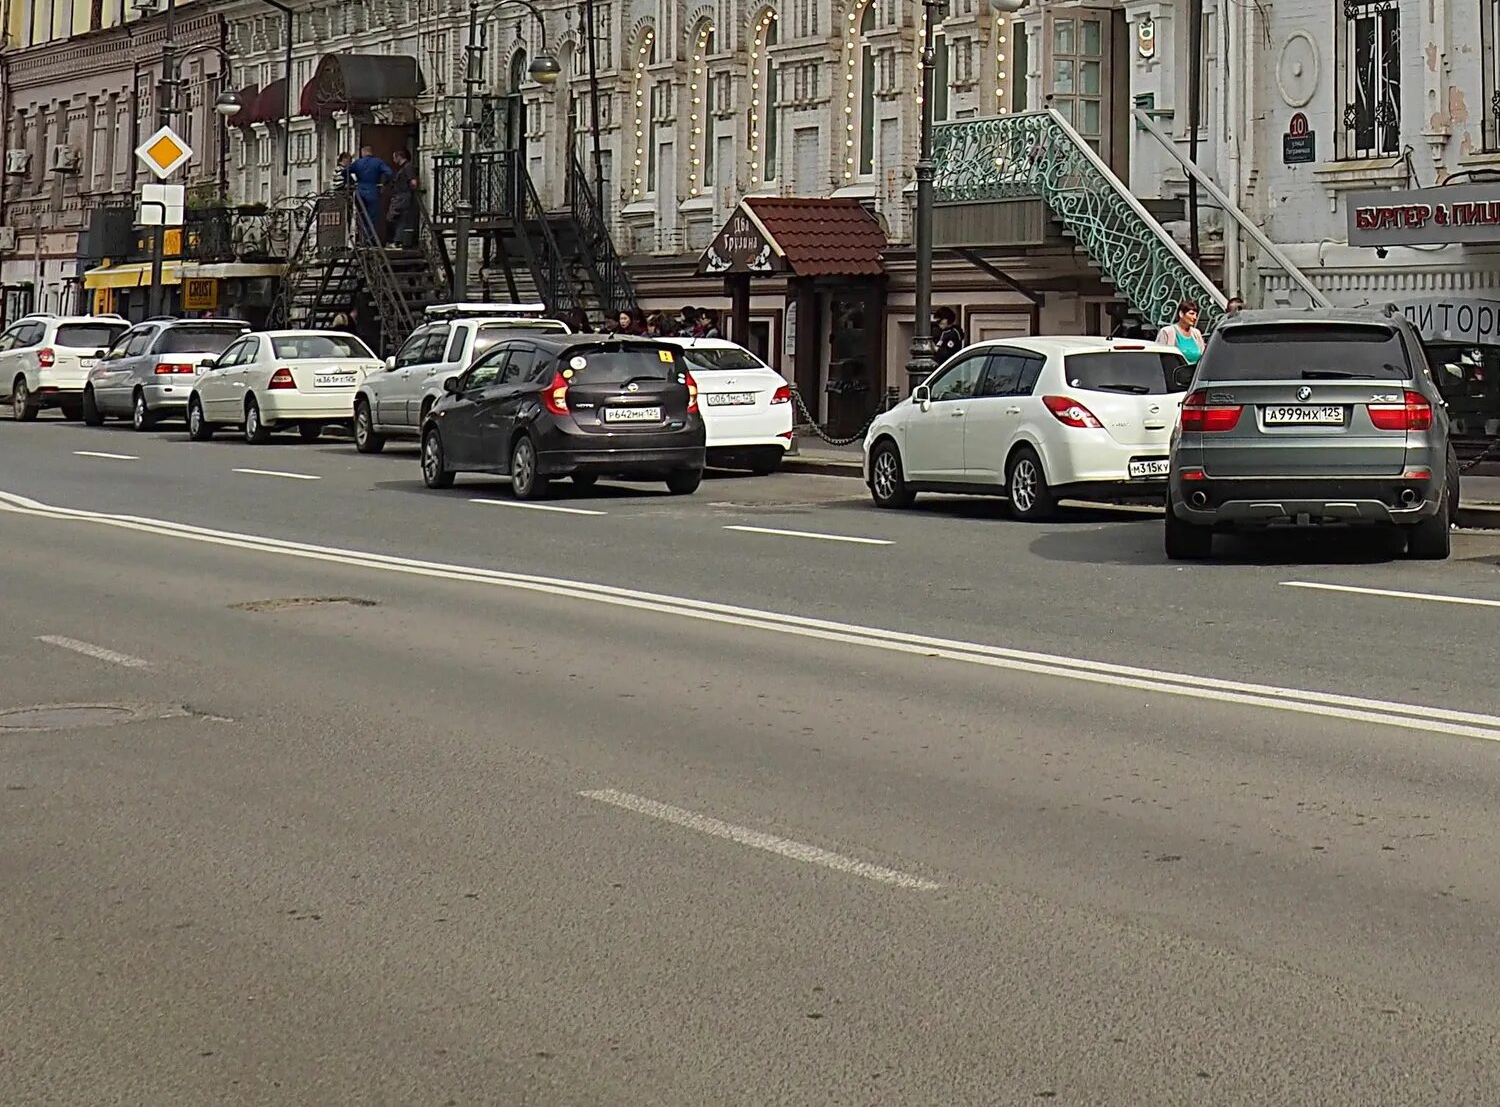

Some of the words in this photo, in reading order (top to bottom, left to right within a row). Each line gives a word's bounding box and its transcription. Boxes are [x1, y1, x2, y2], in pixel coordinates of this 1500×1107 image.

[1292, 118, 1304, 135] 10
[733, 217, 750, 234] Два
[1355, 203, 1432, 230] БУРГЕР
[1433, 203, 1450, 226] &
[723, 234, 758, 253] Грузина
